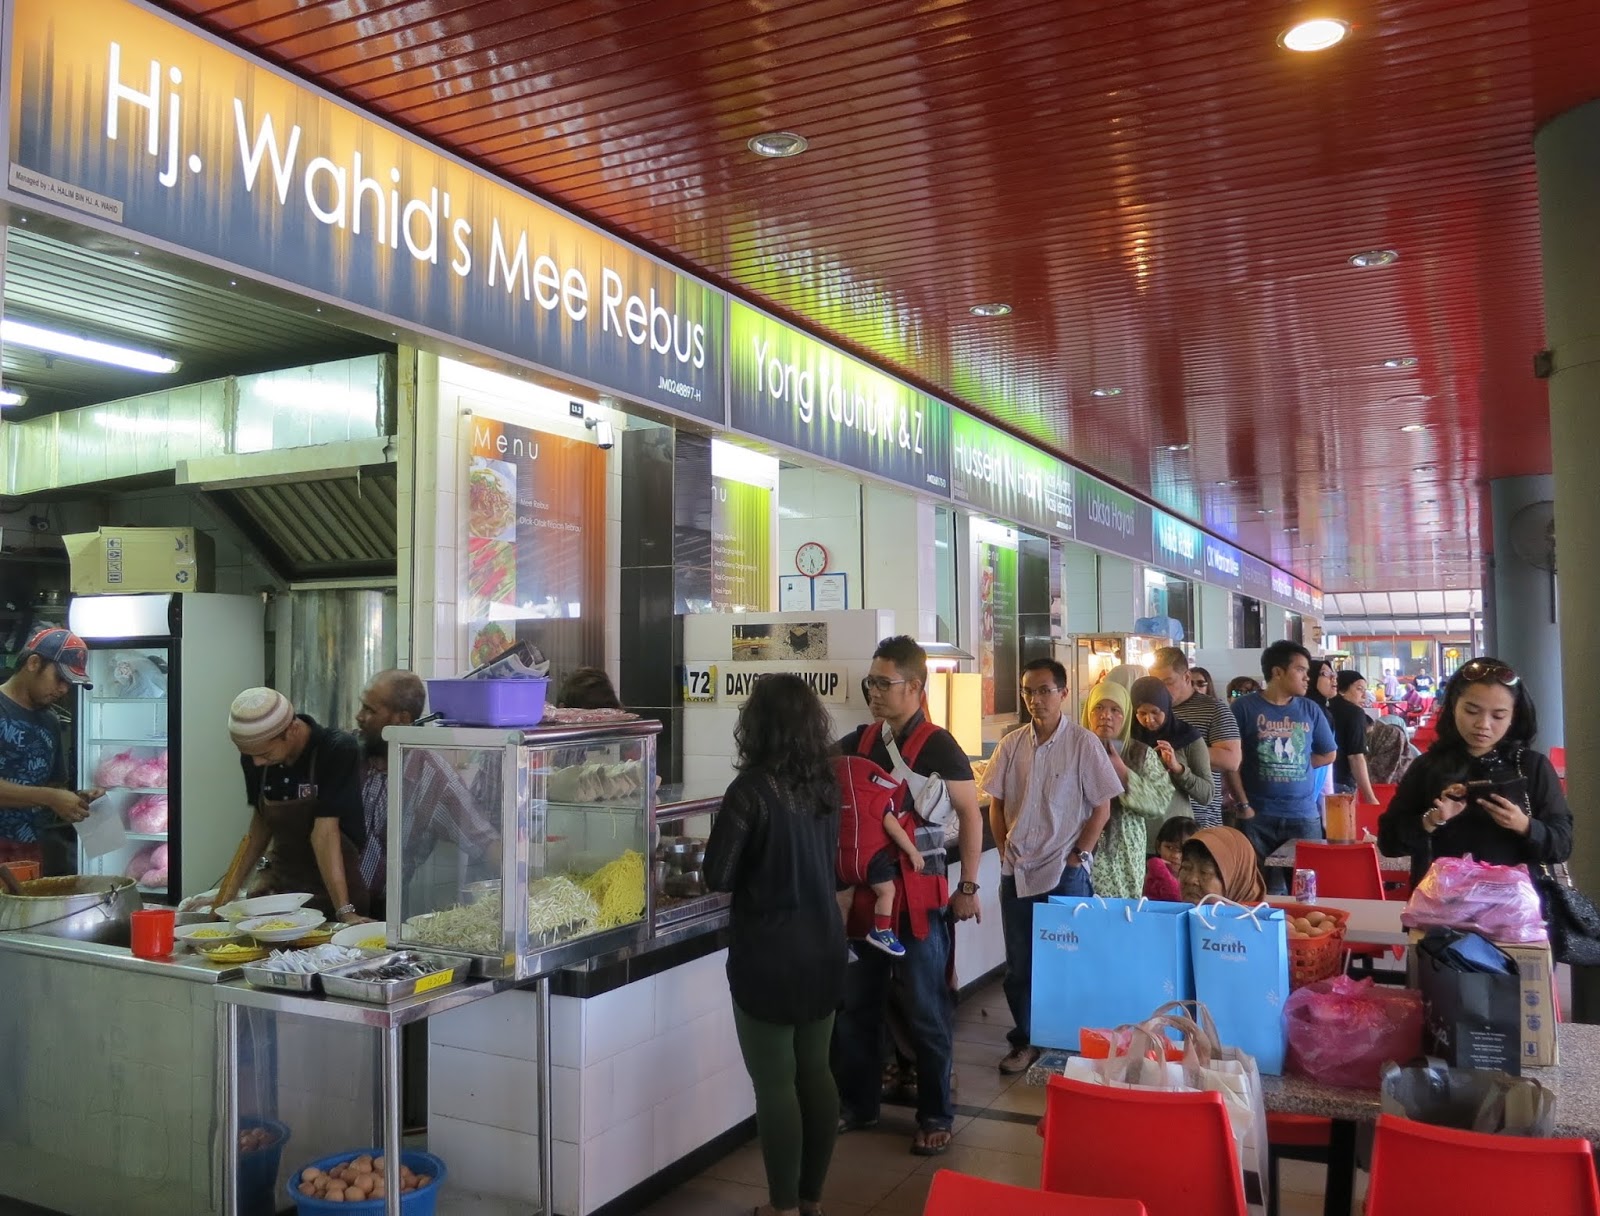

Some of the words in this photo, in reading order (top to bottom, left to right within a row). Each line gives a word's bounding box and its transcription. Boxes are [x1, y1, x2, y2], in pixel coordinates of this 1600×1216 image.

[15, 171, 39, 187] Managed
[57, 188, 75, 199] HALIM
[75, 192, 85, 202] BIN
[101, 201, 118, 214] WAHID
[106, 41, 202, 187] Hj.
[234, 97, 471, 277] Wahid's
[488, 217, 588, 321] Mee
[602, 267, 705, 369] Rebus
[753, 336, 815, 424] Yong
[899, 404, 911, 450] &
[914, 410, 923, 454] Z
[474, 425, 539, 460] Menu
[689, 671, 710, 694] 72
[1040, 928, 1079, 944] Zarith
[1201, 938, 1247, 954] Zarith
